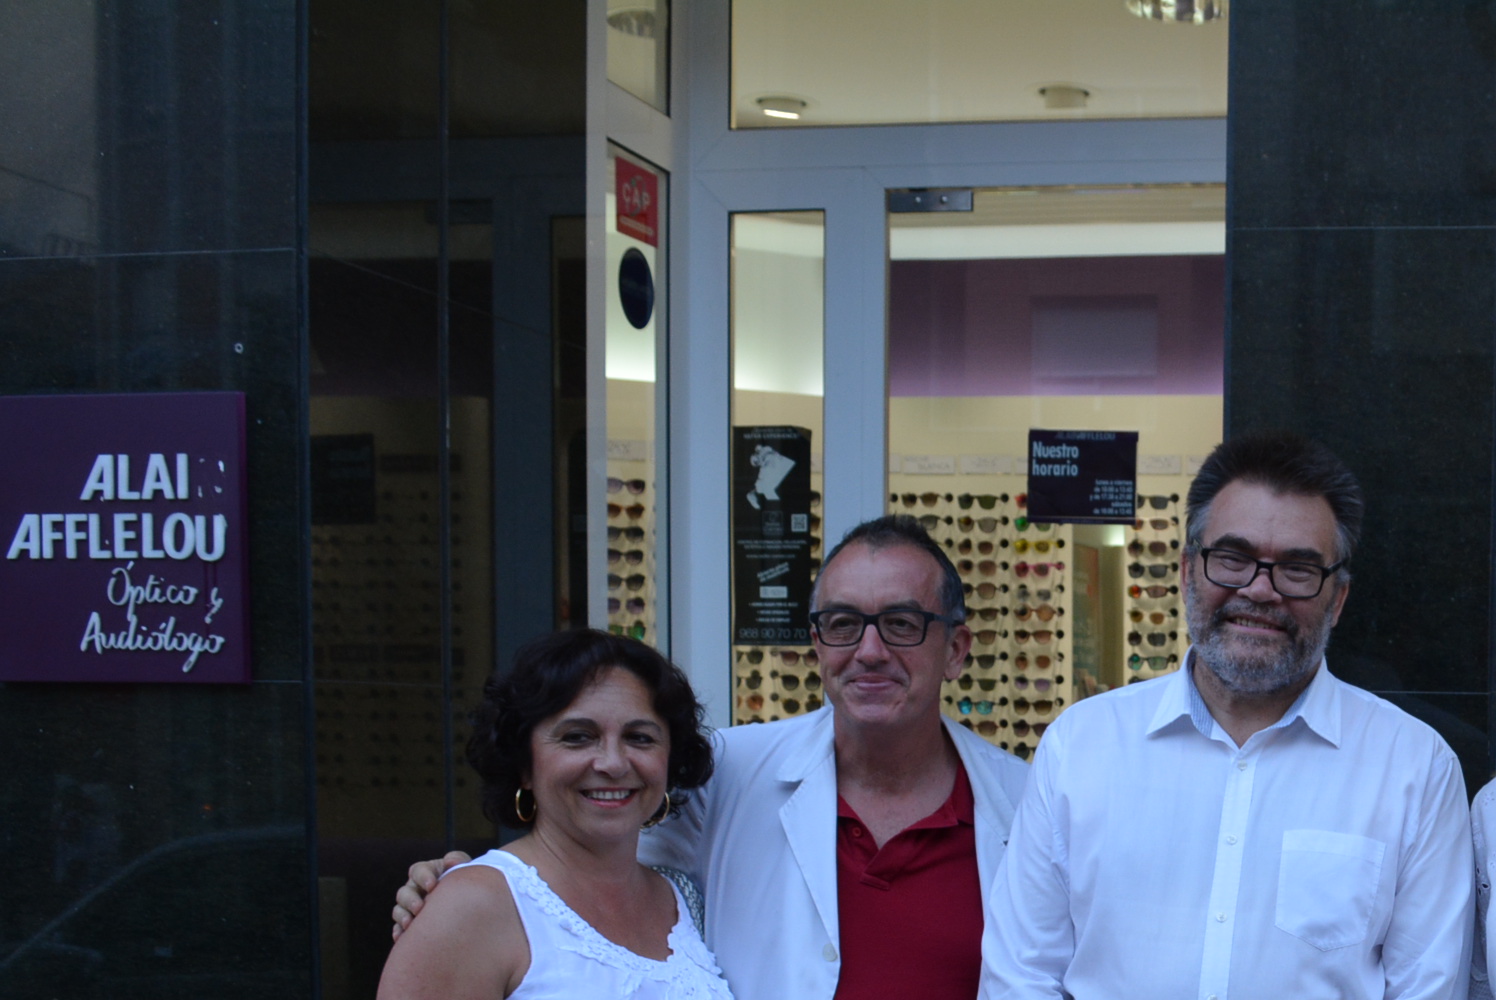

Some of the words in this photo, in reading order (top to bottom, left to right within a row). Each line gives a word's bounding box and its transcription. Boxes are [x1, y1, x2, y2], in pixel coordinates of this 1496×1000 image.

[1032, 441, 1079, 459] Nuestro
[1032, 459, 1078, 476] horario
[6, 512, 227, 562] AFFLELOU
[204, 587, 223, 624] y
